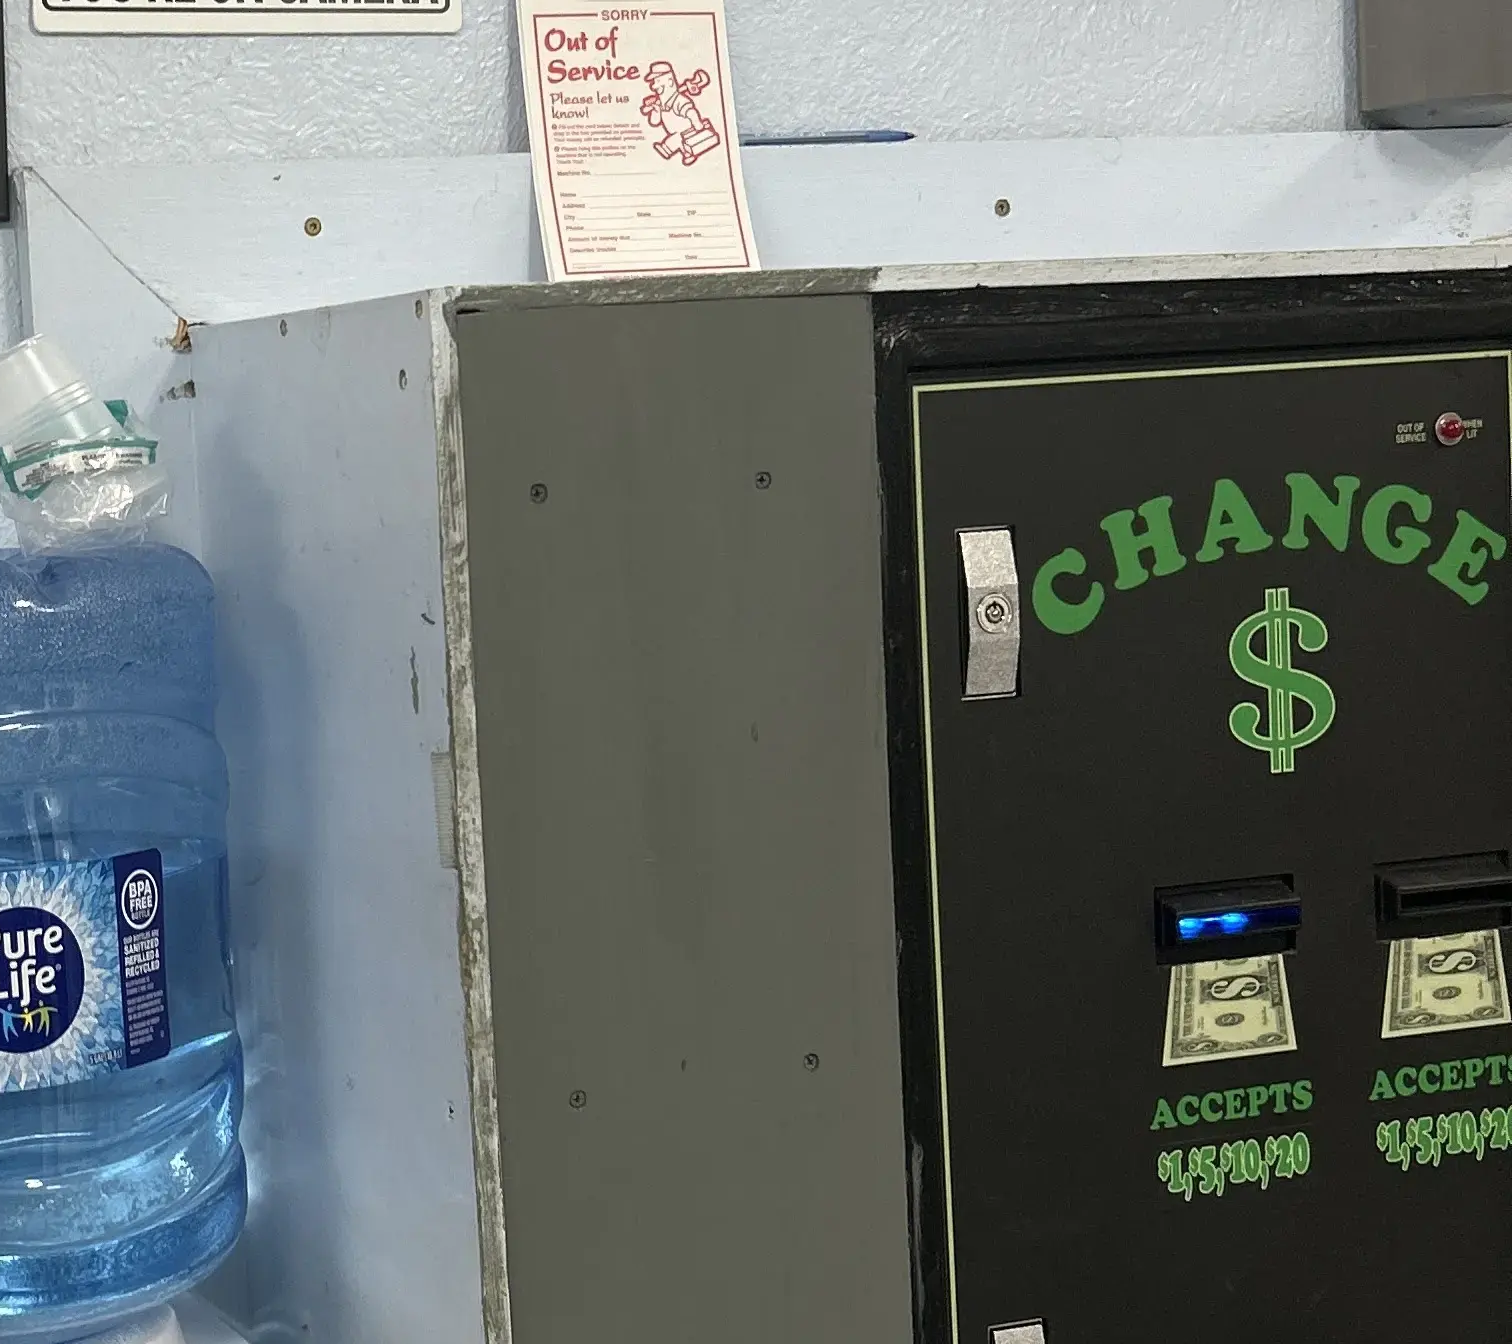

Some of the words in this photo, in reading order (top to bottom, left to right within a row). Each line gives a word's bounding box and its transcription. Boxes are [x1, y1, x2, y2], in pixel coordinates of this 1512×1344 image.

[601, 10, 648, 21] SORRY
[544, 28, 588, 52] Out
[595, 26, 619, 58] of
[548, 59, 640, 84] Service
[550, 92, 594, 105] Please
[597, 91, 612, 105] let
[616, 95, 630, 104] us
[551, 106, 589, 119] know!
[1397, 423, 1412, 433] OUT
[1414, 422, 1424, 431] OF
[1466, 429, 1478, 439] LIT
[1395, 432, 1427, 444] SERVICE
[1031, 472, 1507, 636] CHANGE
[129, 879, 152, 899] BPA
[129, 895, 153, 913] FREE
[124, 937, 160, 956] SANITIZED
[125, 960, 160, 978] RECYCLED
[1150, 1079, 1314, 1130] ACCEPTS
